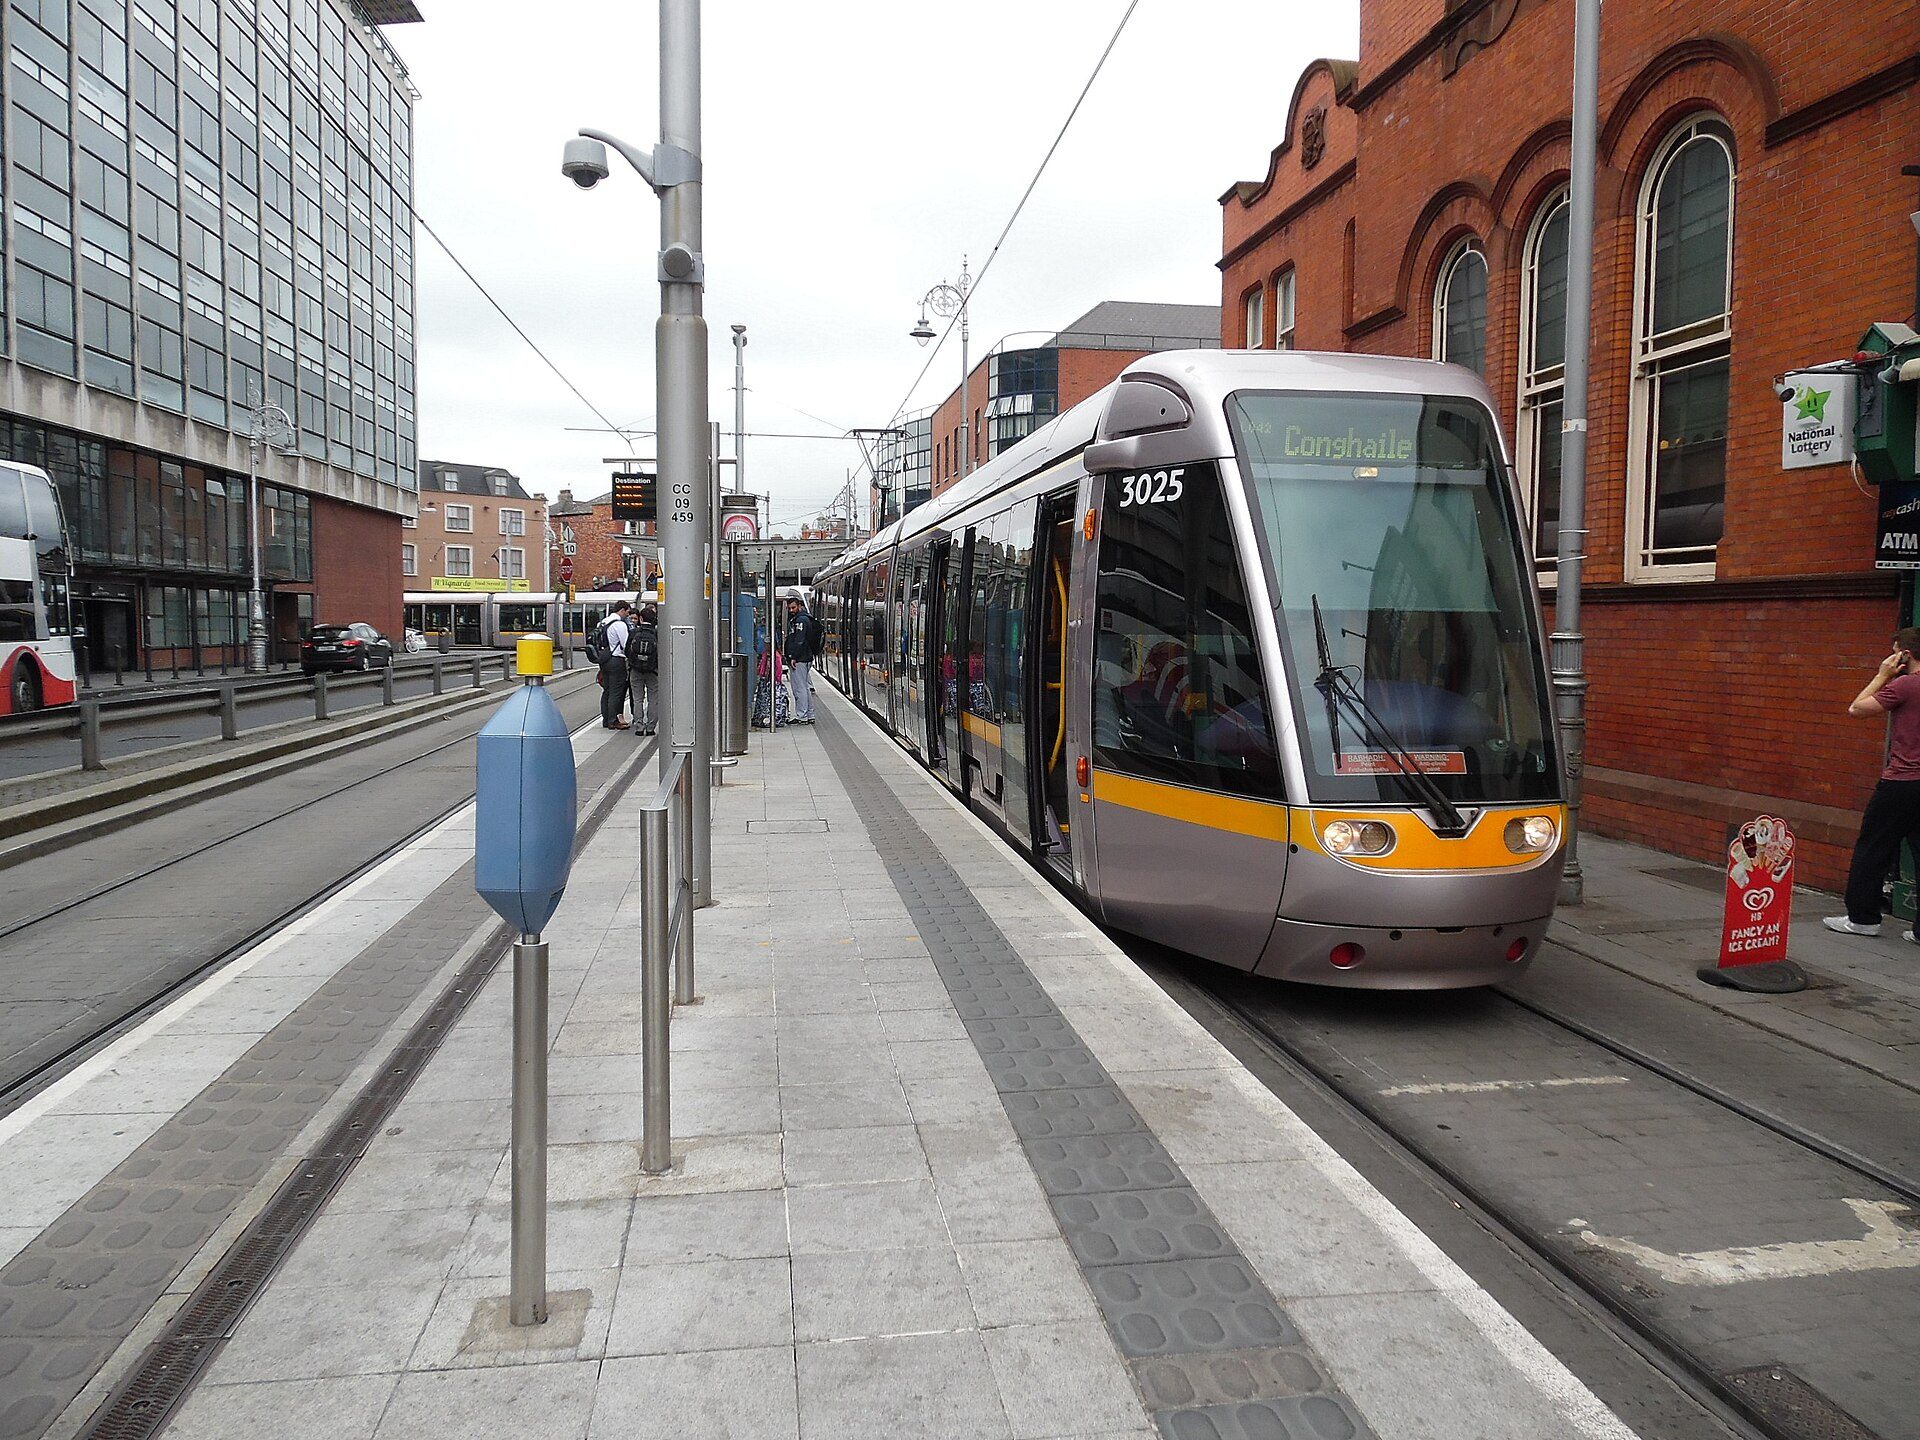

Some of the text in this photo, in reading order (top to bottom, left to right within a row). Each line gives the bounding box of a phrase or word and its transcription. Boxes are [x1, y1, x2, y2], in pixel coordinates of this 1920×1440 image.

[1284, 425, 1413, 459] Conghaile
[1788, 425, 1835, 443] National
[1791, 440, 1831, 453] Lottery
[672, 483, 691, 494] CC
[1120, 469, 1185, 507] 3025
[675, 498, 690, 509] 09
[671, 512, 694, 522] 459
[565, 545, 575, 553] 10
[1881, 532, 1918, 549] ATM
[1731, 923, 1780, 940] FANCY AN
[1728, 935, 1780, 952] ICE CREAM?
